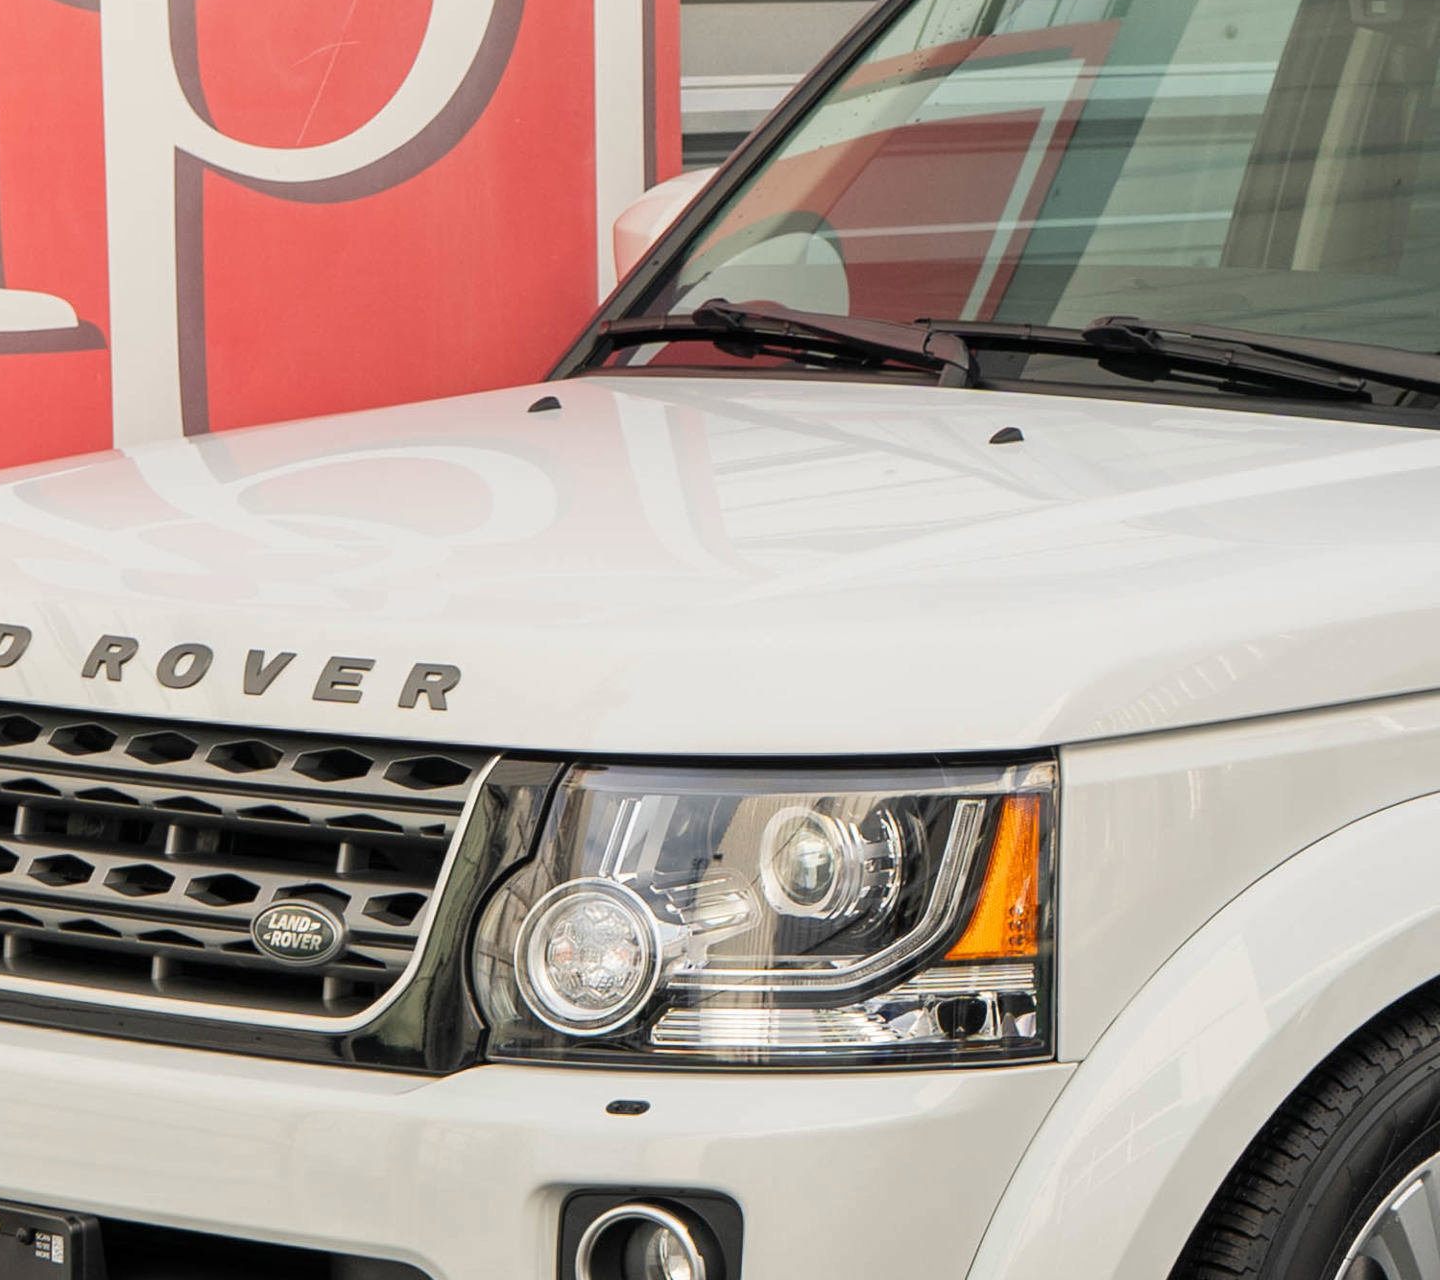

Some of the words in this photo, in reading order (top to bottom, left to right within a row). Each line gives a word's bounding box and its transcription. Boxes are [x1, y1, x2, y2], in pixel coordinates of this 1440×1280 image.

[80, 633, 462, 712] ROVER
[267, 912, 312, 933] LAND
[269, 929, 323, 952] ROVER
